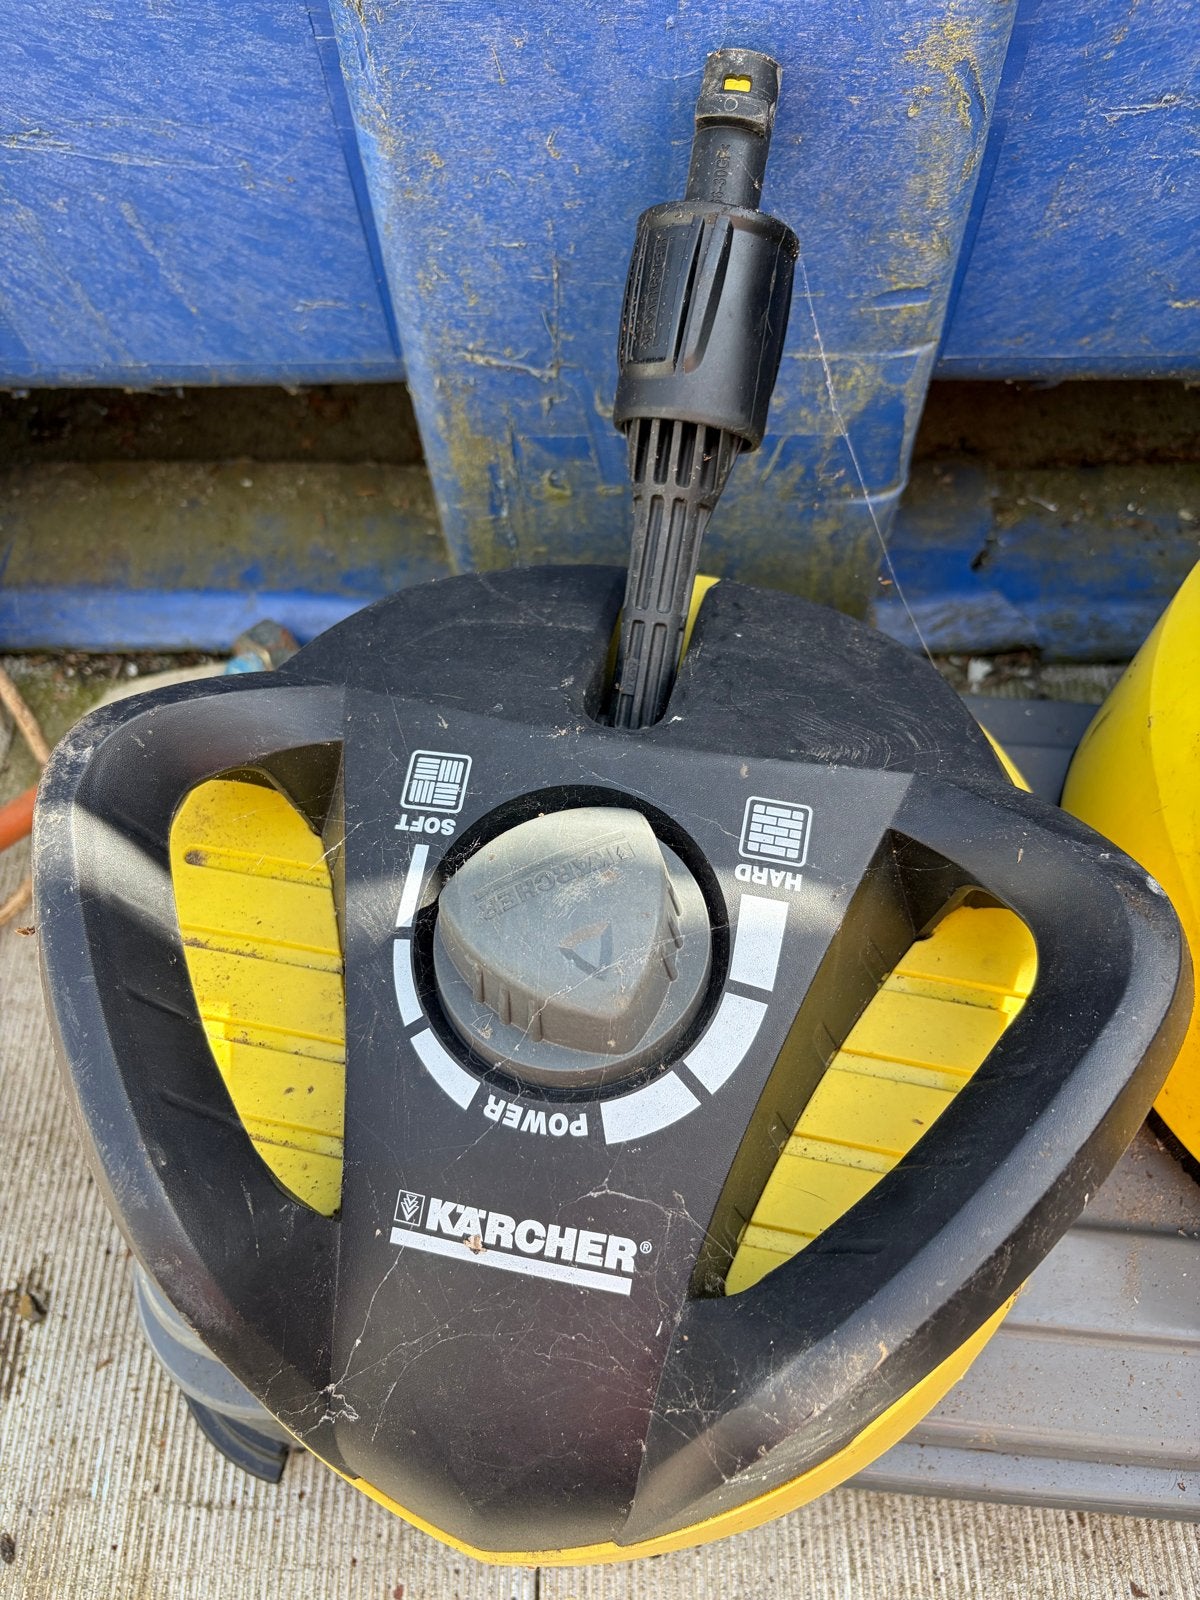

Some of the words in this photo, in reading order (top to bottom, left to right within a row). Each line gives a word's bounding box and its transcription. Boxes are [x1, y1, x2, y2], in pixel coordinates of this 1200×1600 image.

[395, 815, 456, 836] SOFT
[735, 863, 802, 892] HARD
[483, 1093, 588, 1137] POWER
